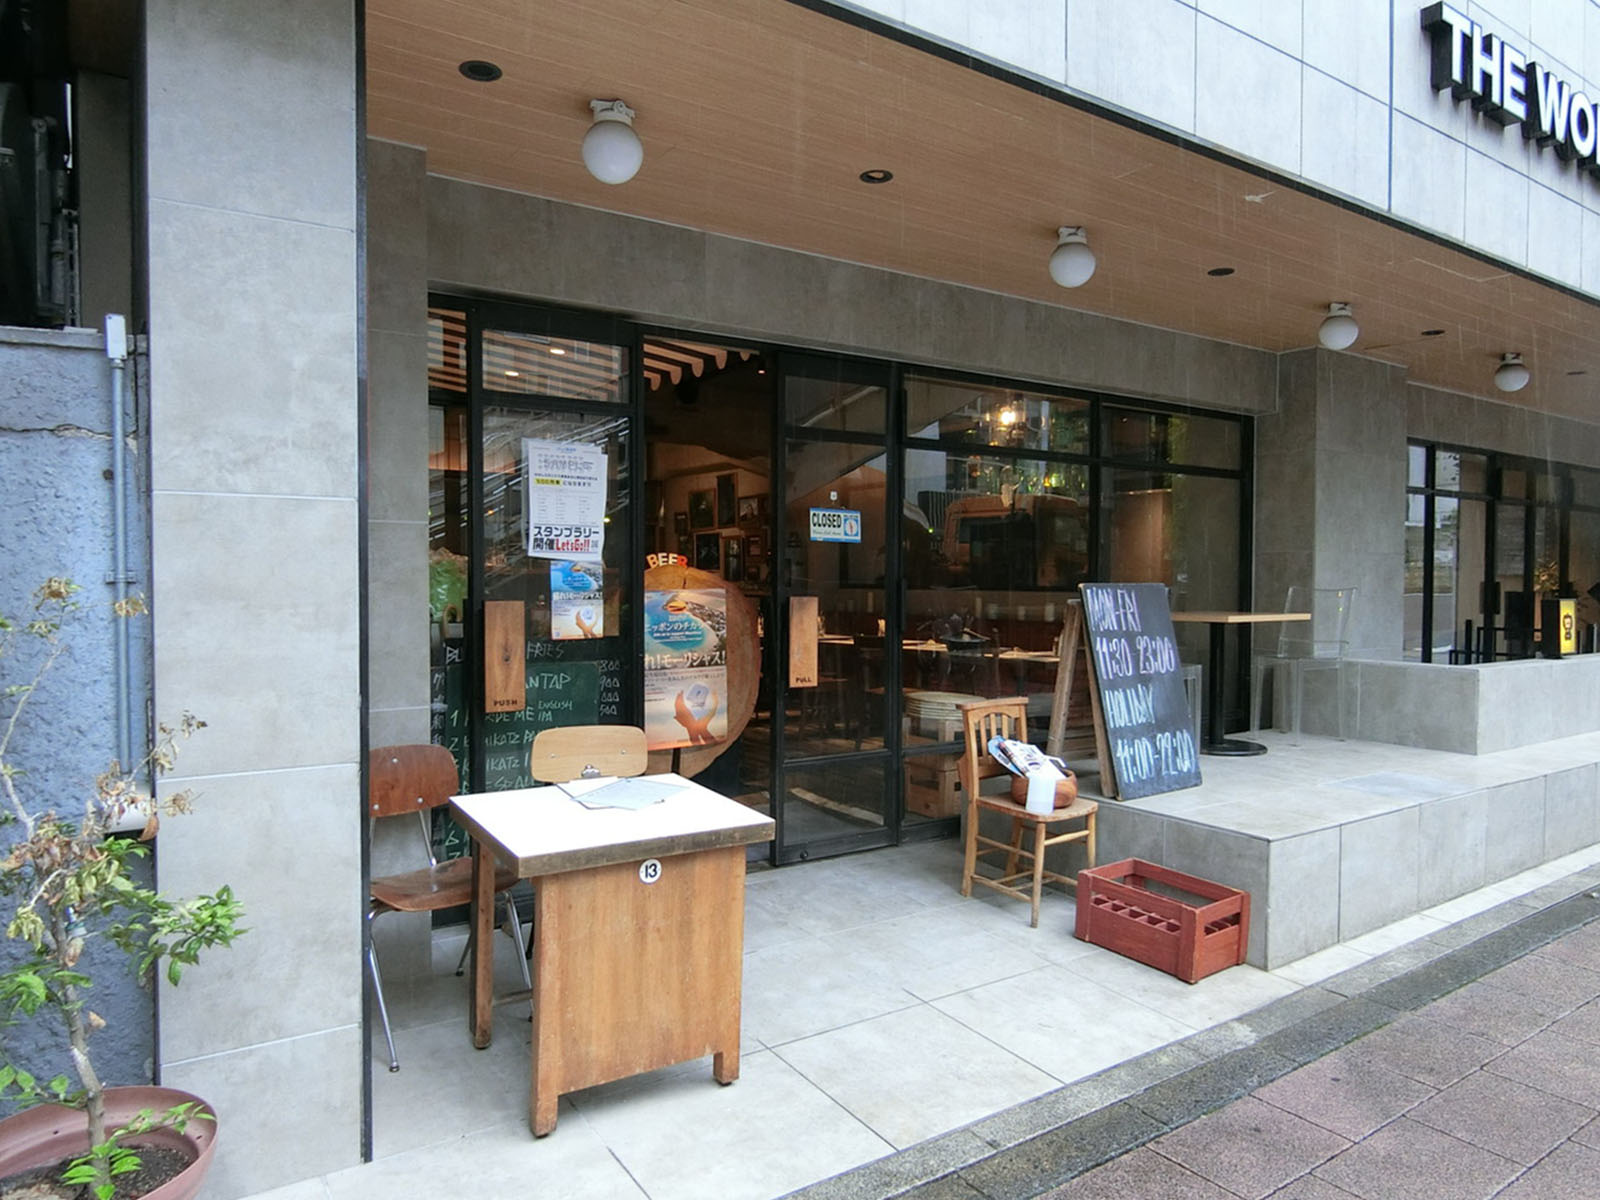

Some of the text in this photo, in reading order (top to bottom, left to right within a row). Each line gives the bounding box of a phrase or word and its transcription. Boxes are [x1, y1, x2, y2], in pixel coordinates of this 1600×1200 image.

[1442, 3, 1600, 165] THE WO
[812, 512, 842, 528] CLOSED
[646, 552, 689, 569] BEER
[644, 863, 658, 878] 13
